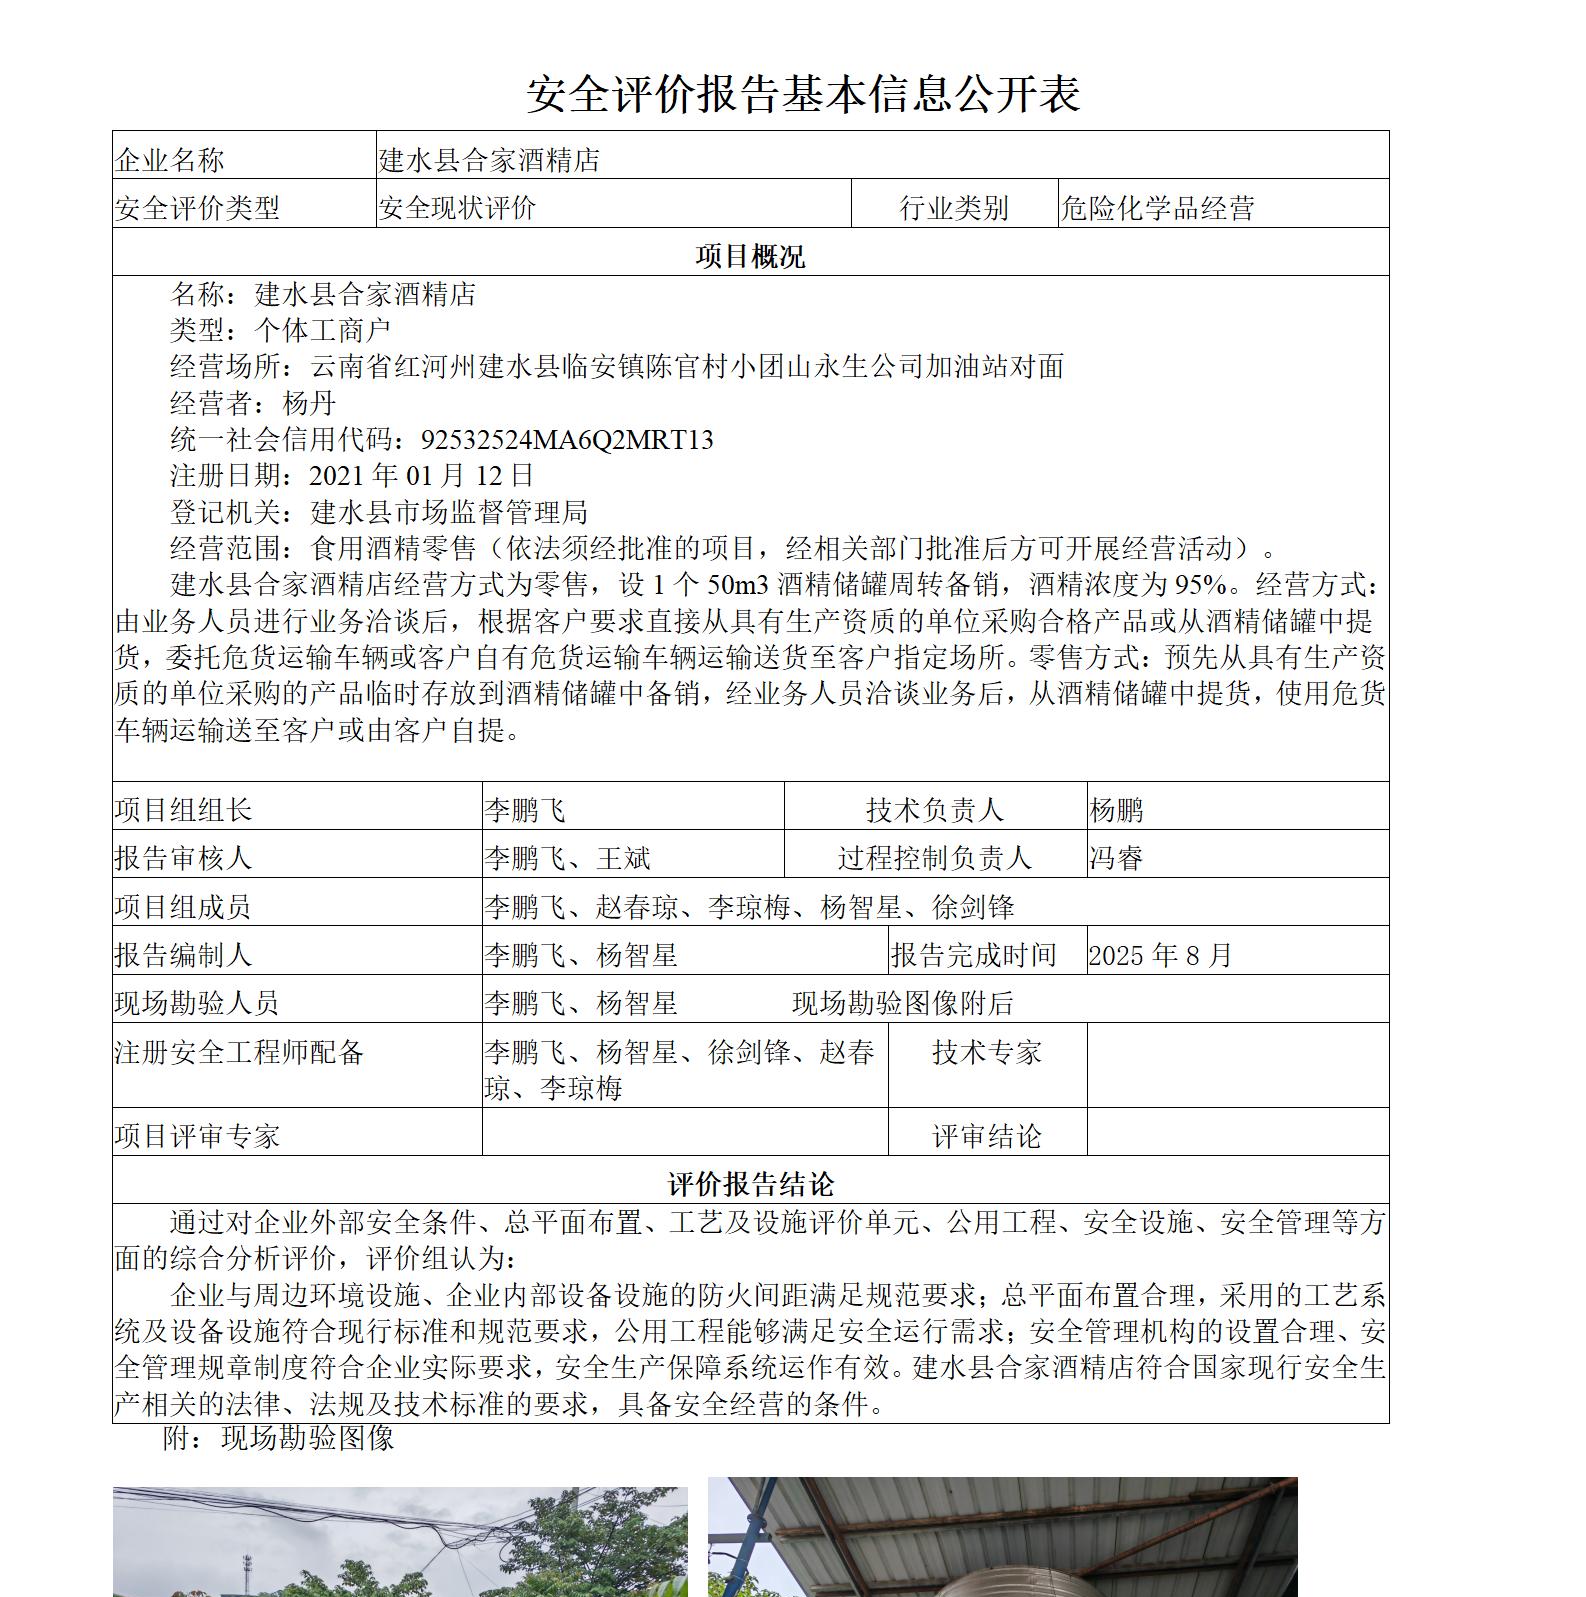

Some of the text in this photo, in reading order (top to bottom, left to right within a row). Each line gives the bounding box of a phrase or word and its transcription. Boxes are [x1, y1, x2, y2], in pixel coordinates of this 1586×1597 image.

[527, 74, 1080, 114] 安全评价报告基本信息公开表
[115, 147, 224, 173] 企业名称
[378, 147, 600, 173] 建水县合家酒精店
[115, 195, 280, 221] 安全评价类型
[378, 195, 537, 221] 安全现状评价
[900, 195, 1009, 221] 行业类别
[1061, 195, 1255, 221] 危险化学品经营
[696, 243, 806, 269] 项目概况
[170, 281, 476, 307] 名称：建水县合家酒精店
[170, 317, 390, 343] 类型：个体工商户
[170, 353, 1065, 379] 经营场所：云南省红河州建水县临安镇陈官村小团山永生公司加油站对面
[170, 390, 337, 416] 经营者：杨丹
[170, 426, 714, 454] 统一社会信用代码：92532524MA6Q2MRT13
[170, 499, 587, 525] 登记机关：建水县市场监督管理局
[170, 535, 1272, 561] 经营范围：食用酒精零售（依法须经批准的项目，经相关部门批准后方可开展经营活动）。
[116, 608, 1373, 634] 由业务人员进行业务洽谈后，根据客户要求直接从具有生产资质的单位采购合格产品或从酒精储罐中提
[115, 644, 1386, 670] 货，委托危货运输车辆或客户自有危货运输车辆运输送货至客户指定场所。零售方式：预先从具有生产资
[115, 680, 1386, 706] 质的单位采购的产品临时存放到酒精储罐中备销，经业务人员洽谈业务后，从酒精储罐中提货，使用危货
[115, 717, 523, 743] 车辆运输送至客户或由客户自提。
[115, 797, 253, 823] 项目组组长
[484, 797, 566, 823] 李鹏飞
[866, 797, 1005, 823] 技术负责人
[1089, 797, 1144, 823] 杨鹏
[115, 845, 253, 871] 报告审核人
[484, 845, 651, 871] 李鹏飞、王斌
[838, 845, 1033, 871] 过程控制负责人
[1089, 845, 1143, 871] 冯睿
[115, 894, 250, 920] 项目组成员
[484, 894, 1015, 920] 李鹏飞、赵春琼、李琼梅、杨智星、徐剑锋
[115, 942, 253, 968] 报告编制人
[484, 942, 678, 968] 李鹏飞、杨智星
[890, 942, 1057, 968] 报告完成时间
[115, 990, 278, 1016] 现场勘验人员
[484, 990, 1014, 1016] 李鹏飞、杨智星 现场勘验图像附后
[115, 1039, 364, 1065] 注册安全工程师配备
[484, 1039, 875, 1065] 李鹏飞、杨智星、徐剑锋、赵春
[931, 1039, 1042, 1065] 技术专家
[484, 1075, 623, 1101] 琼、李琼梅
[115, 1123, 280, 1149] 项目评审专家
[931, 1123, 1042, 1149] 评审结论
[667, 1171, 835, 1197] 评价报告结论
[169, 1209, 1386, 1235] 通过对企业外部安全条件、总平面布置、工艺及设施评价单元、公用工程、安全设施、安全管理等方
[115, 1245, 519, 1271] 面的综合分析评价，评价组认为：
[170, 1282, 1386, 1308] 企业与周边环境设施、企业内部设备设施的防火间距满足规范要求；总平面布置合理，采用的工艺系
[115, 1318, 1386, 1344] 统及设备设施符合现行标准和规范要求，公用工程能够满足安全运行需求；安全管理机构的设置合理、安
[115, 1354, 1386, 1380] 全管理规章制度符合企业实际要求，安全生产保障系统运作有效。建水县合家酒精店符合国家现行安全生
[115, 1391, 882, 1417] 产相关的法律、法规及技术标准的要求，具备安全经营的条件。
[163, 1426, 395, 1451] 附：现场勘验图像
